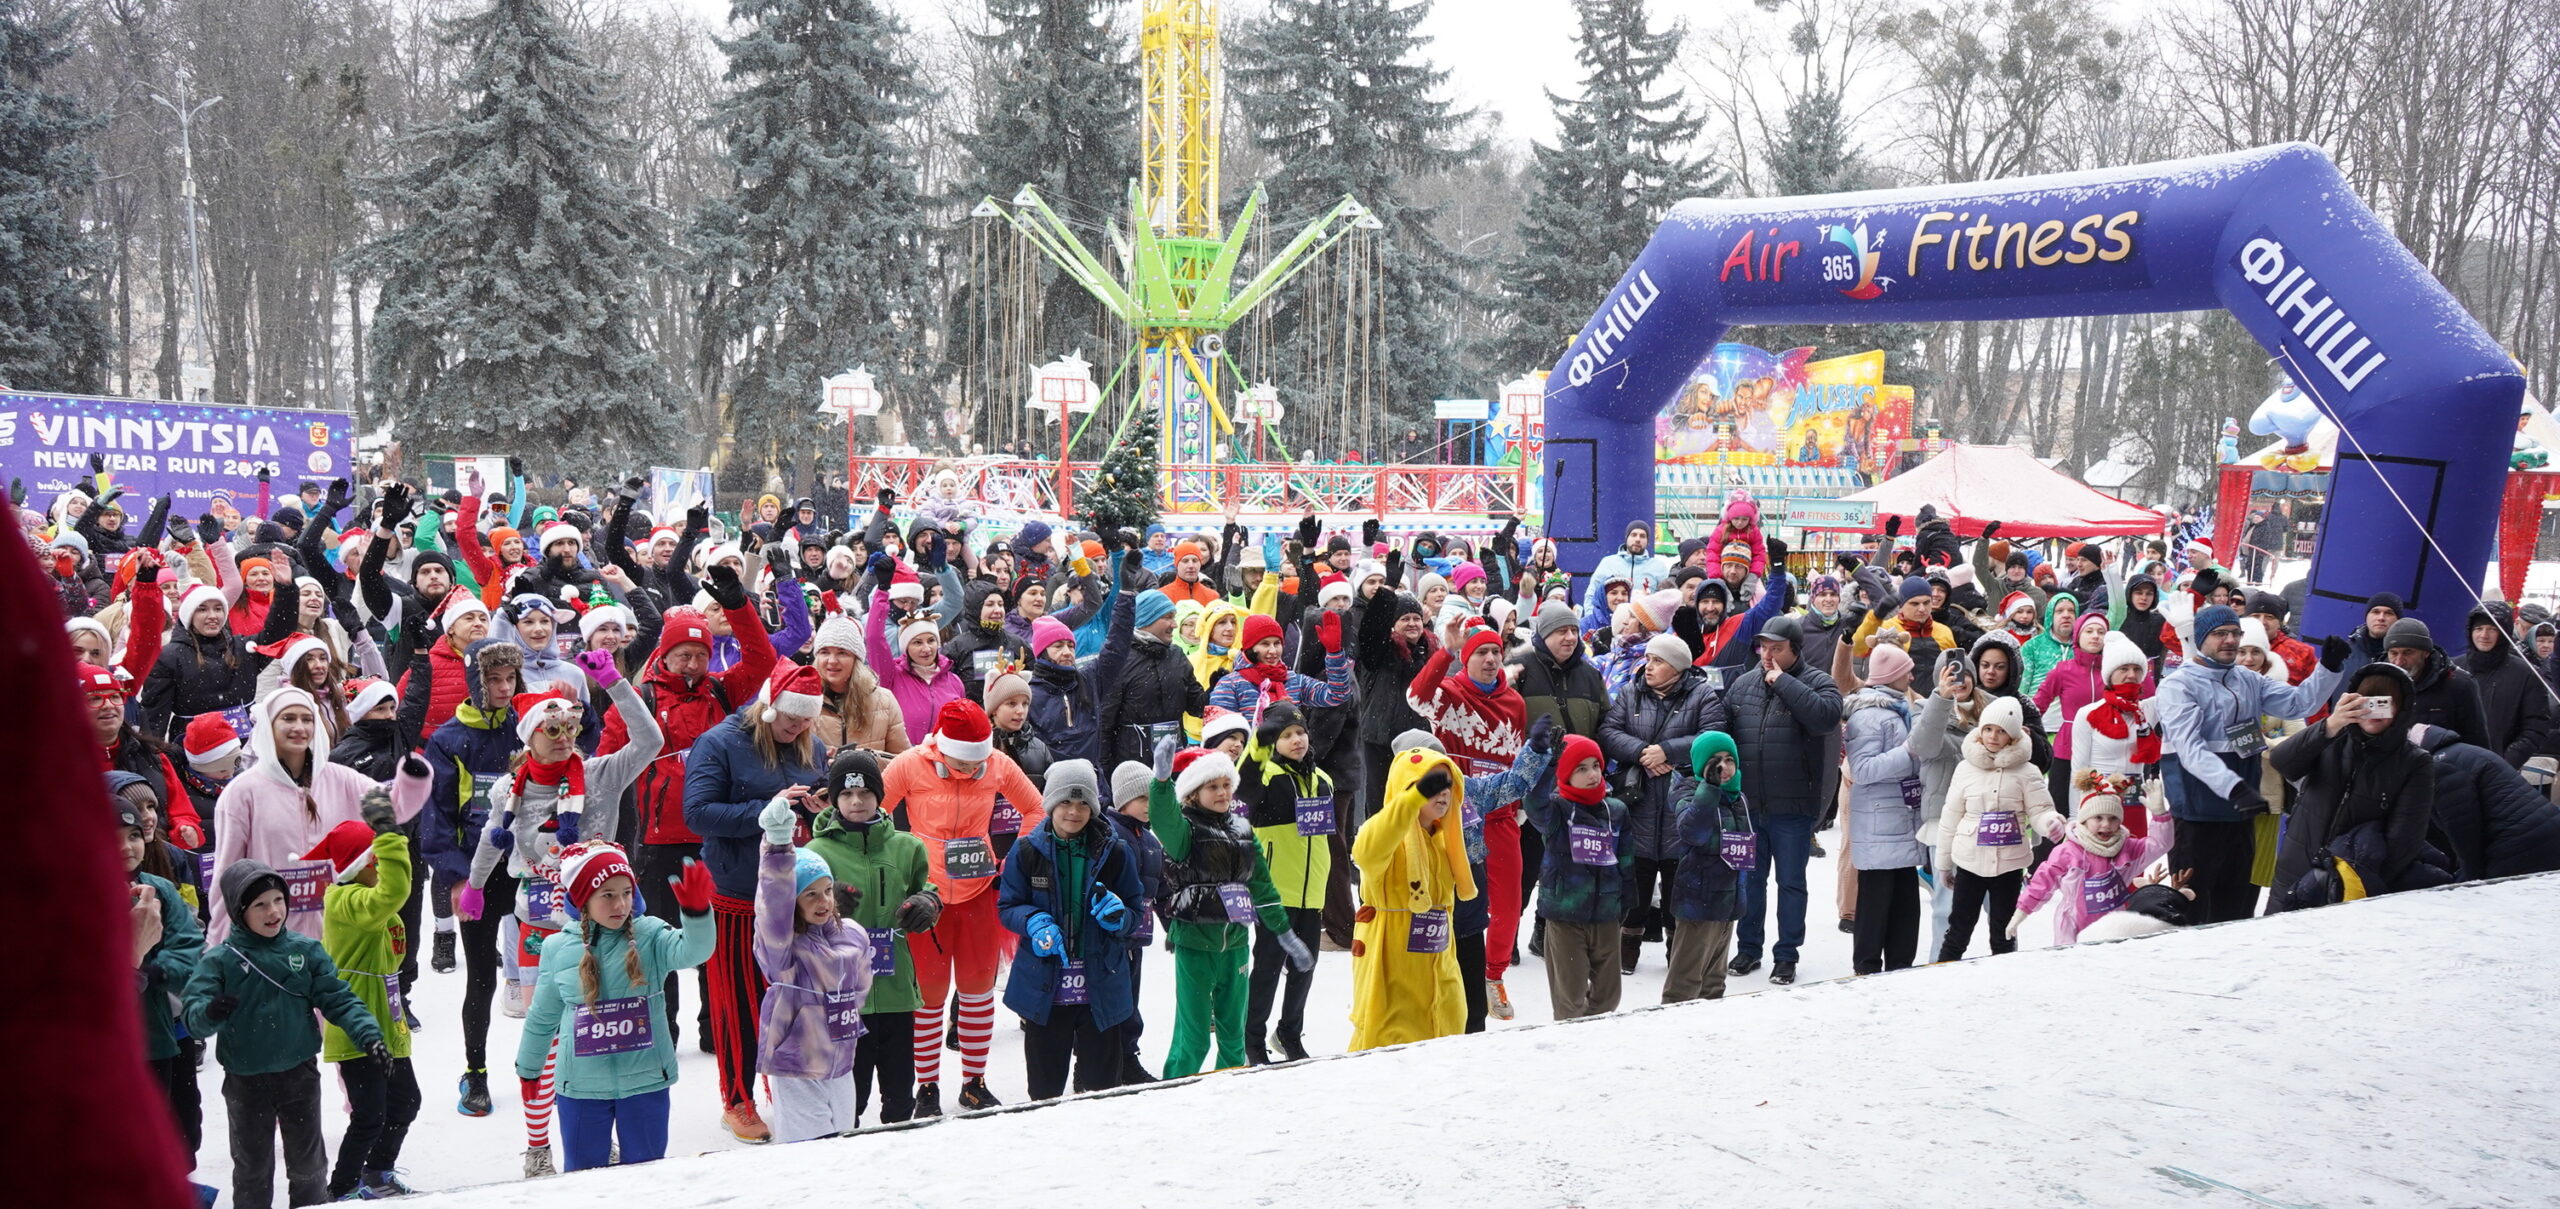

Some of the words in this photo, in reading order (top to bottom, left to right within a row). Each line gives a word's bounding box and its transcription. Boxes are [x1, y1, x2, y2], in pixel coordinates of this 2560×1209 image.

[1719, 227, 1799, 283] Air
[1822, 255, 1854, 282] 365
[1907, 210, 2139, 277] Fitness
[2240, 238, 2387, 392] ФІНІШ
[1568, 268, 1661, 387] ФІНІШ
[1783, 382, 1875, 431] MUSIC
[29, 411, 281, 457] VINNYTSIA
[34, 451, 89, 470] NEW
[168, 457, 216, 475] RUN
[1790, 511, 1806, 520] AIR
[1807, 511, 1841, 521] FITNESS
[1843, 512, 1860, 521] 365
[2236, 734, 2254, 747] 893
[1303, 810, 1325, 824] 345
[1989, 822, 2012, 834] 912
[1583, 838, 1602, 852] 915
[1729, 844, 1747, 856] 914
[960, 851, 986, 864] 807
[591, 868, 609, 889] OH
[289, 881, 317, 897] 611
[2095, 883, 2120, 903] 947
[1236, 895, 1252, 909] 314
[591, 1019, 634, 1039] 950
